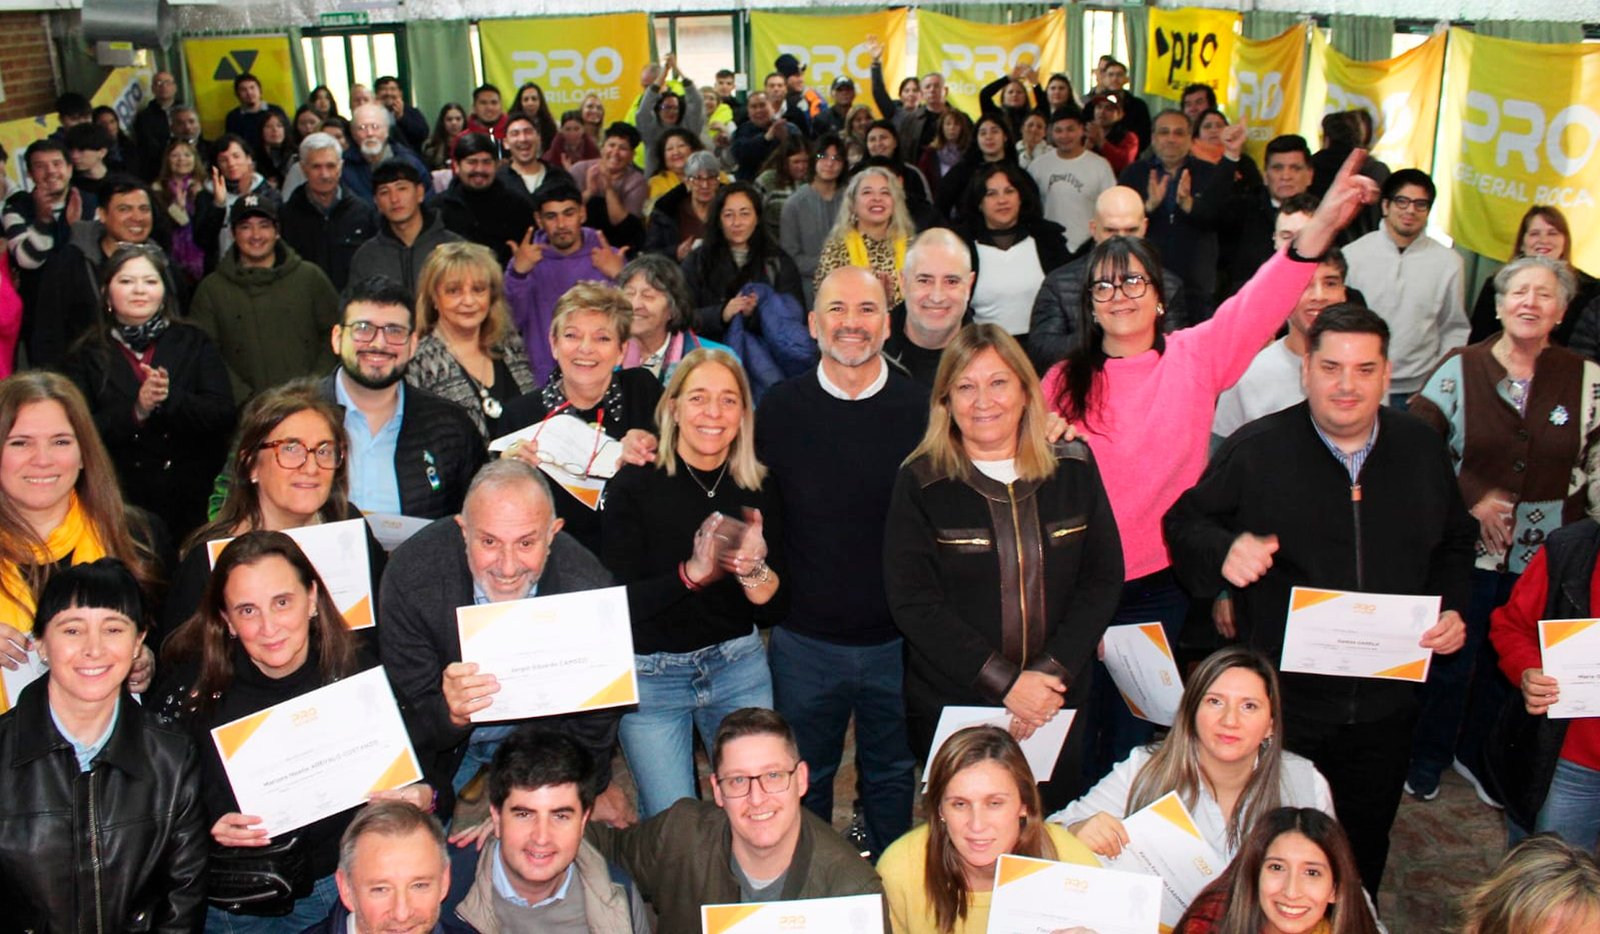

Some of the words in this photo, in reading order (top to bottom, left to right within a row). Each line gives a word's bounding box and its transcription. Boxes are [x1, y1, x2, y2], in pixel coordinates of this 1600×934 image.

[511, 46, 623, 88] PRO
[777, 44, 873, 82] PRO
[942, 43, 1041, 81] PRO
[1168, 31, 1218, 85] pro
[545, 86, 621, 103] RILOCHE
[1463, 90, 1600, 178] PRO
[1533, 184, 1594, 208] ROCA
